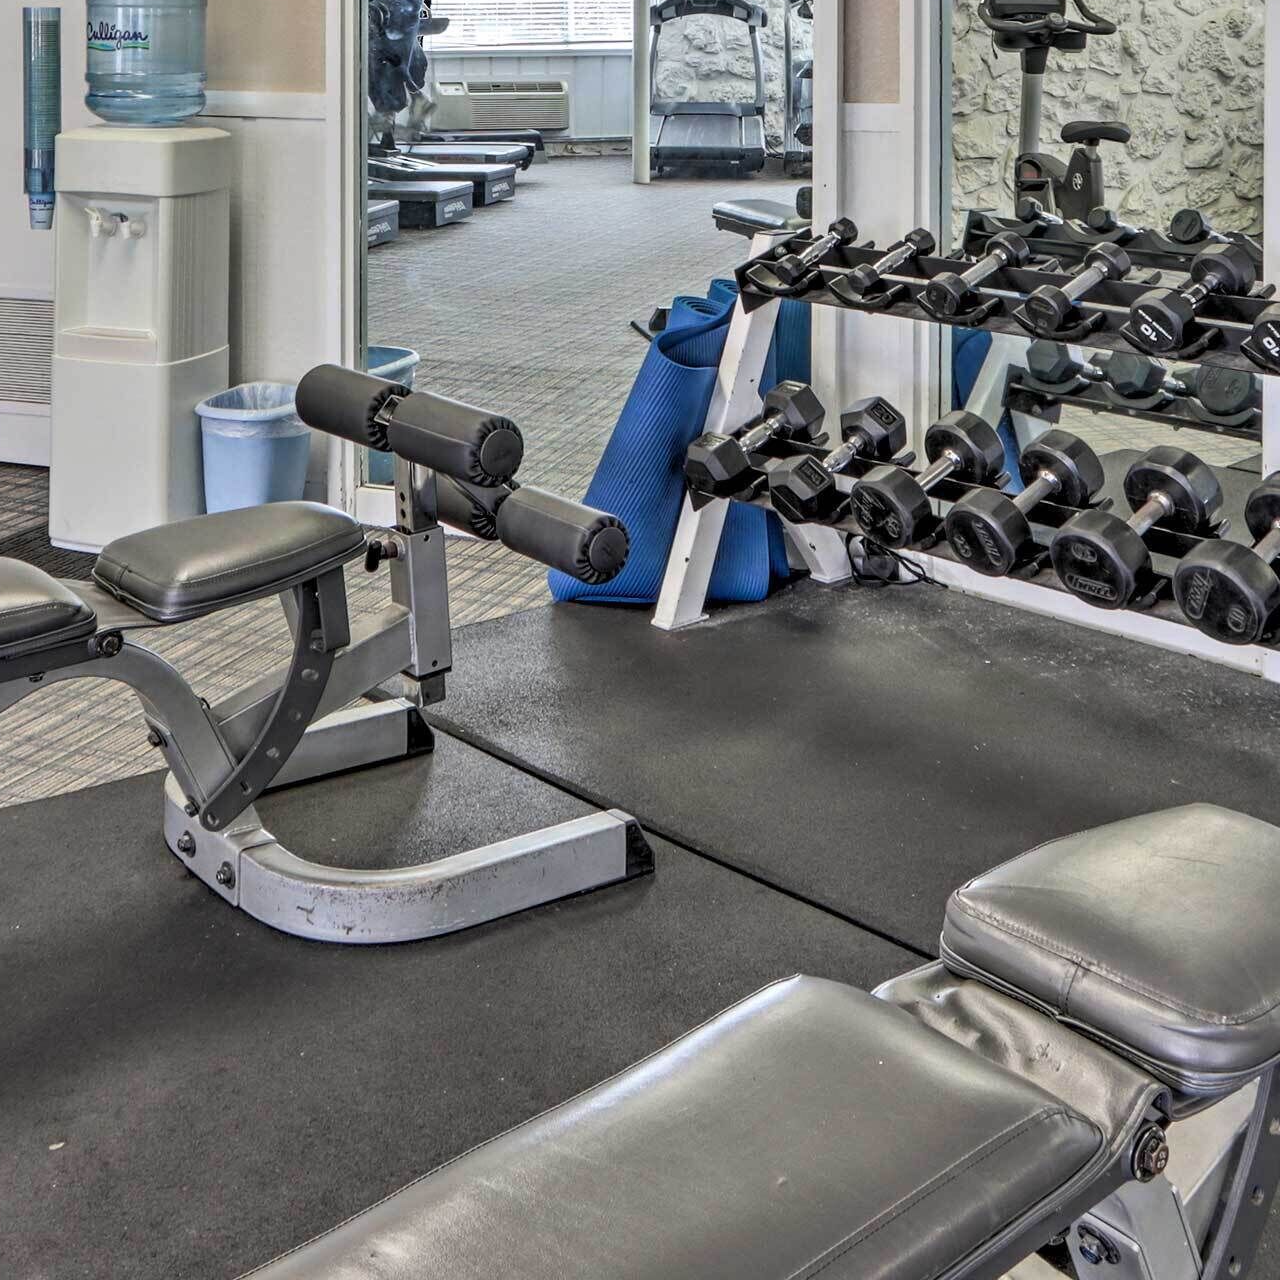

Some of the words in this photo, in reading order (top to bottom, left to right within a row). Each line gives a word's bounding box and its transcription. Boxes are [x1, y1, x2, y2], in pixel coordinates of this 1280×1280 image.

[86, 21, 148, 50] Culligan
[1140, 323, 1157, 341] 10
[1263, 336, 1280, 357] 10
